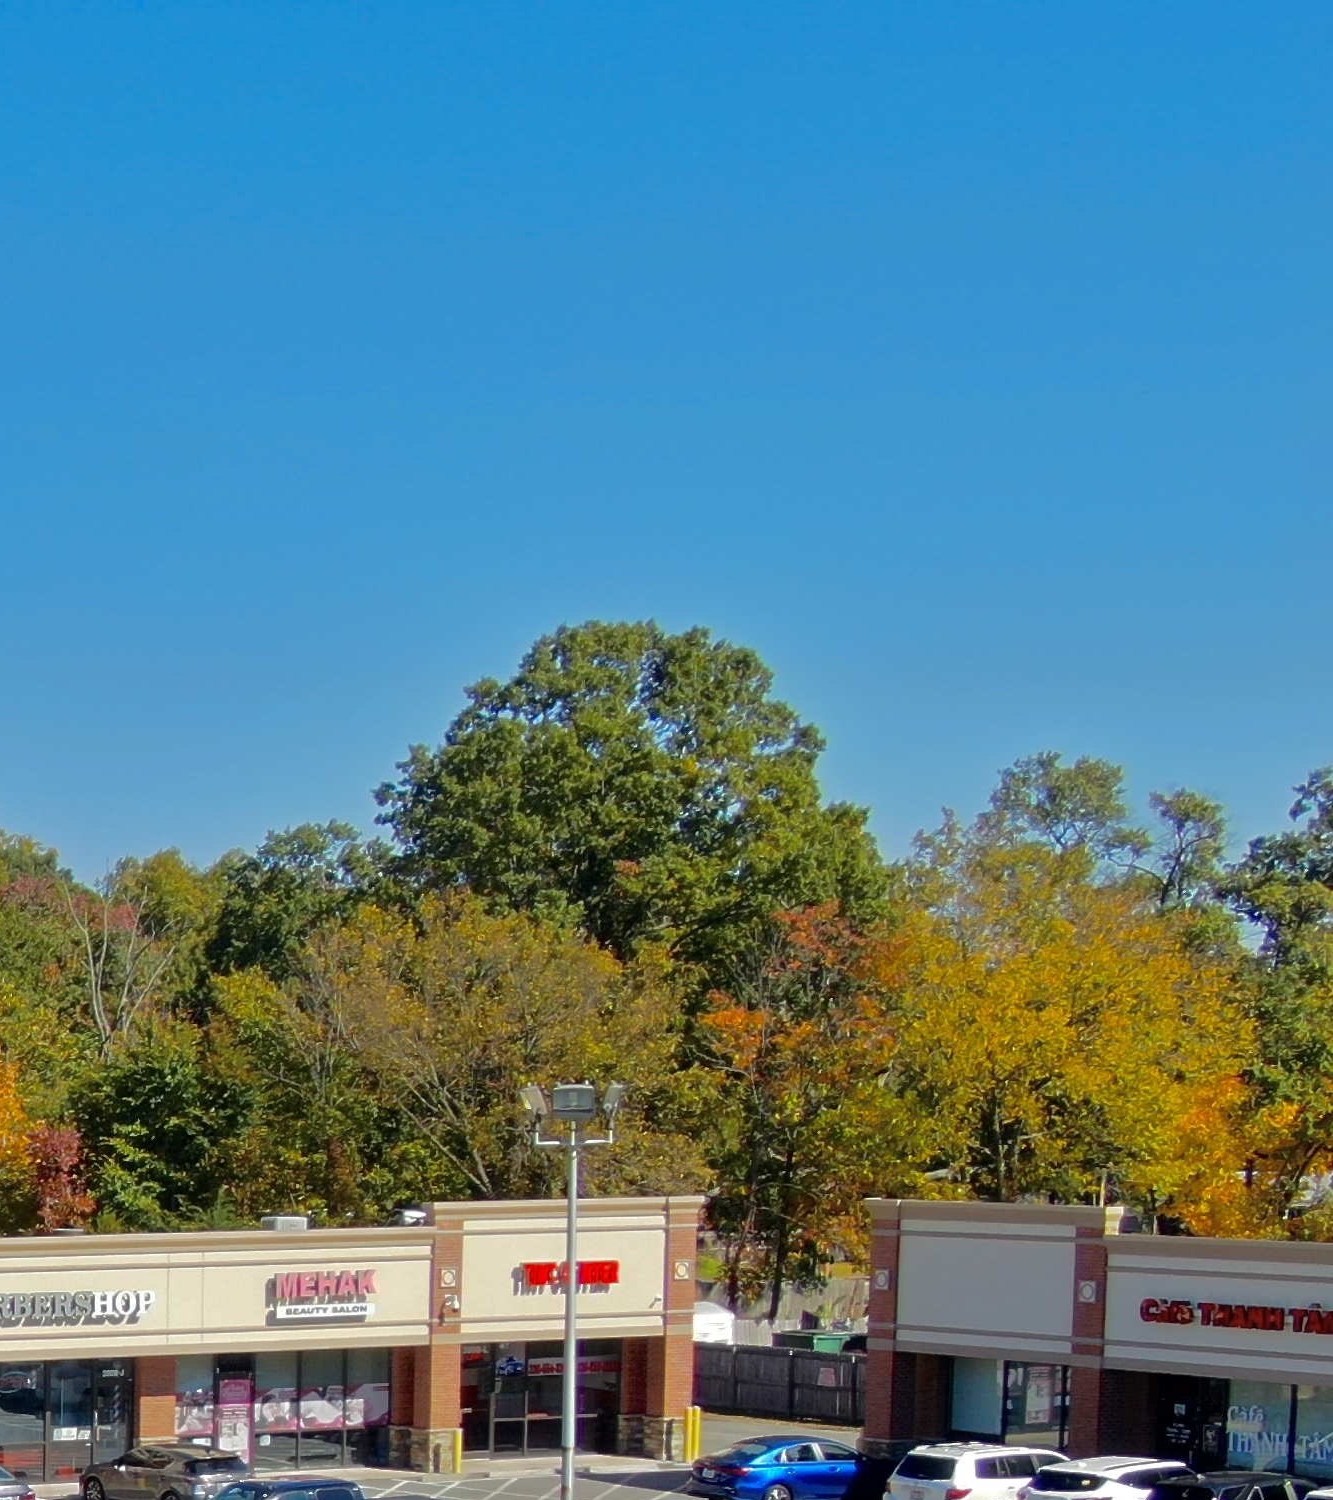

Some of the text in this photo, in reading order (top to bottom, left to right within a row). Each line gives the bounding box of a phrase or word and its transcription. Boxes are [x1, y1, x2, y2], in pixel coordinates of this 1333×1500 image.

[276, 1269, 377, 1298] MEHAK
[559, 1260, 620, 1285] CNTER
[285, 1305, 368, 1315] BEAUTY SALON
[1197, 1302, 1285, 1331] THANH
